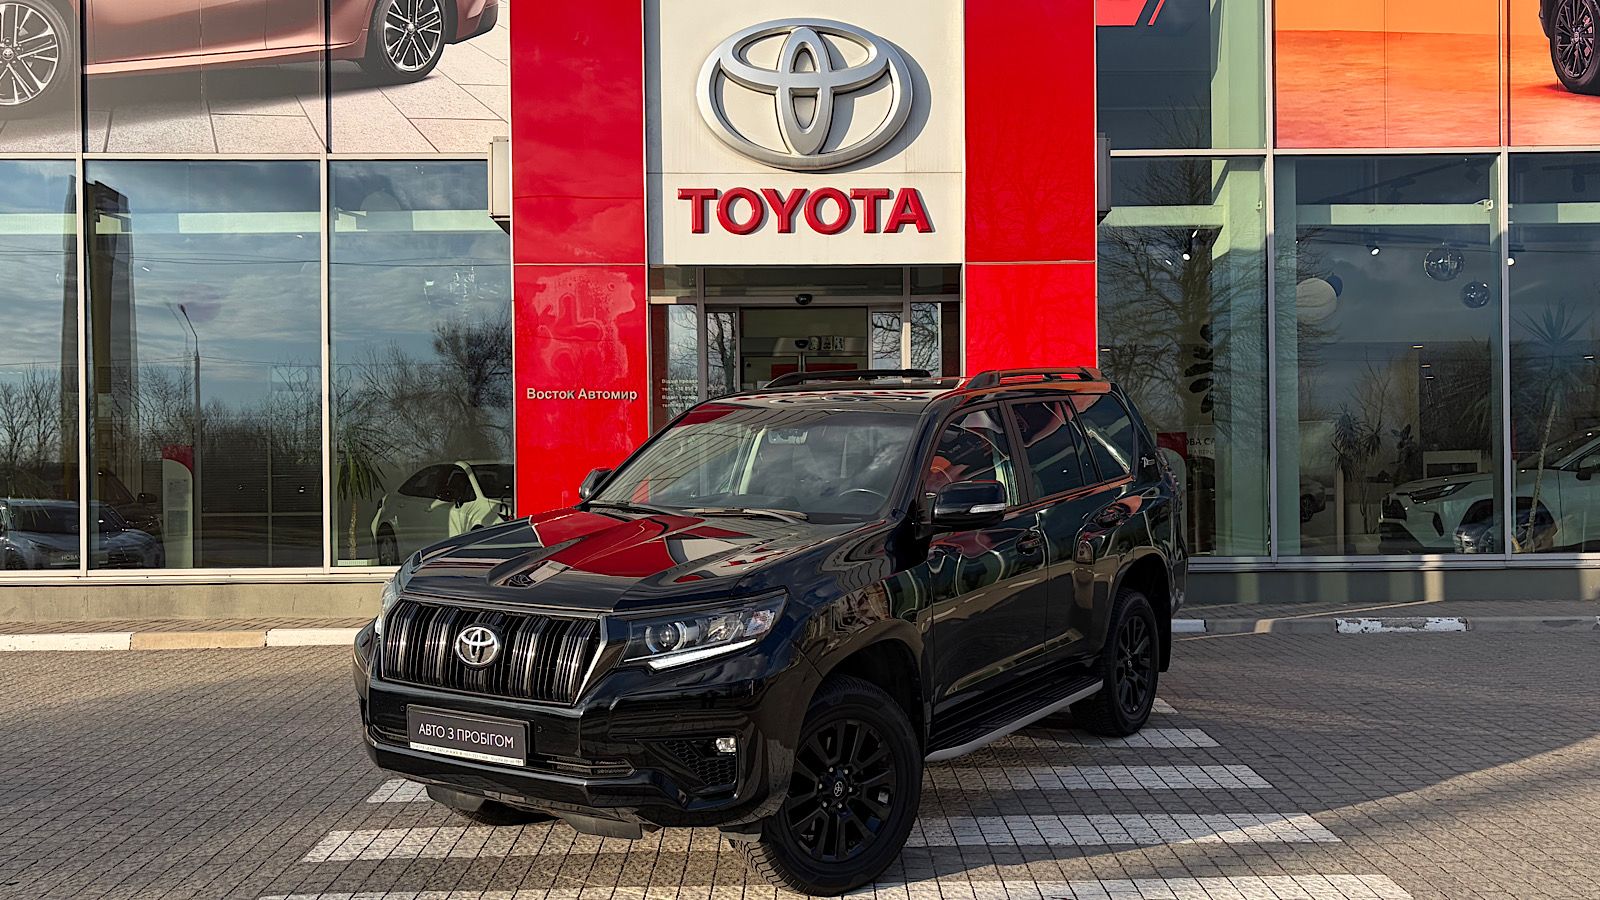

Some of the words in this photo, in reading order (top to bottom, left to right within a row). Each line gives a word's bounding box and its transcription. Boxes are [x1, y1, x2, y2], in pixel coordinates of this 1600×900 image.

[678, 187, 933, 235] TOYOTA
[526, 387, 576, 400] Восток
[578, 387, 639, 402] Автомир
[418, 723, 446, 738] АВТО
[456, 728, 514, 749] ПРОБІГОМ
